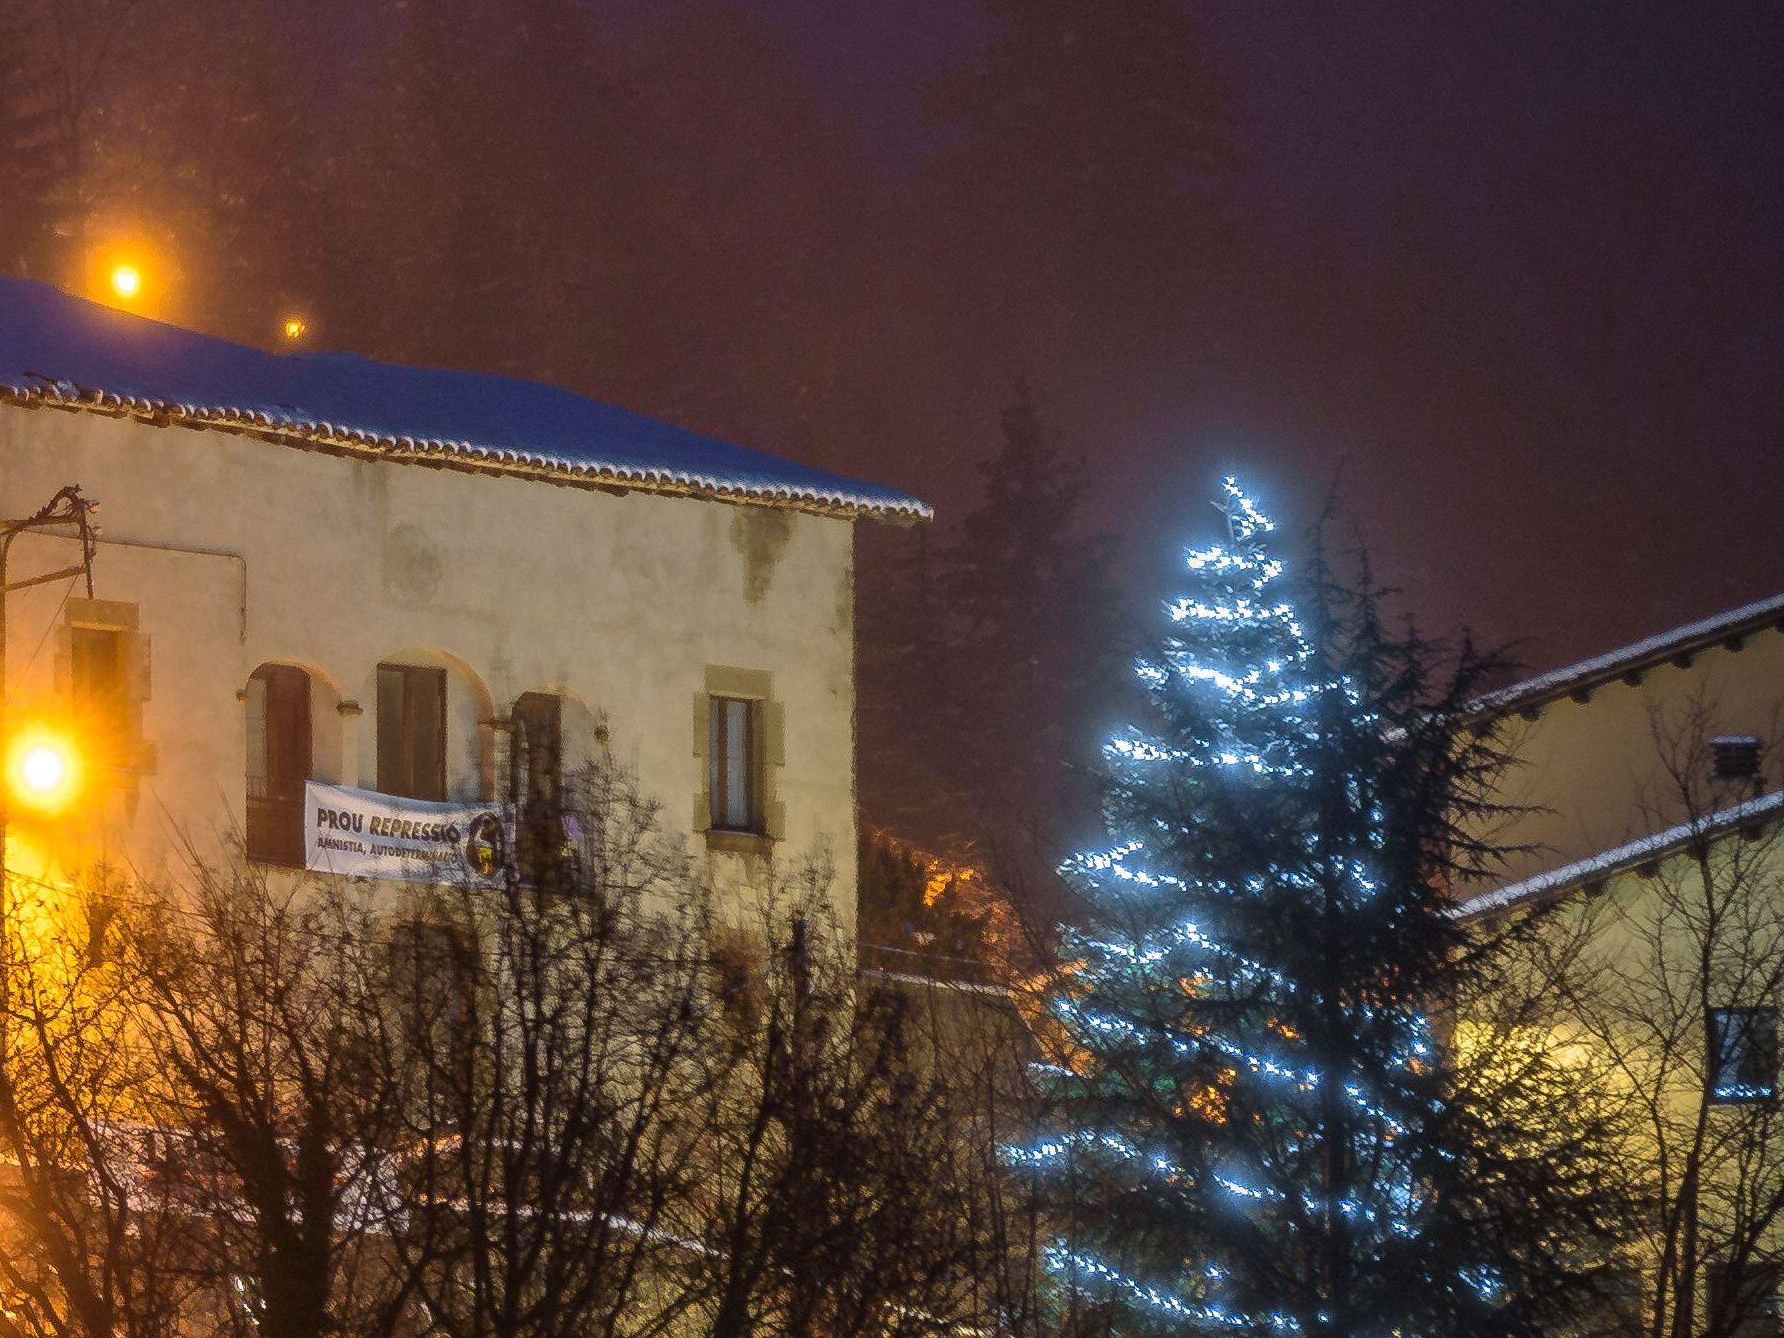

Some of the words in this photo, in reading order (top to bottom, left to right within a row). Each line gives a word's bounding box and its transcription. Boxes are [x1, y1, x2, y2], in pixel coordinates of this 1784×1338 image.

[317, 807, 364, 833] PROU
[369, 816, 461, 843] REPRESSIÓ
[317, 837, 365, 855] AMNISTIA,
